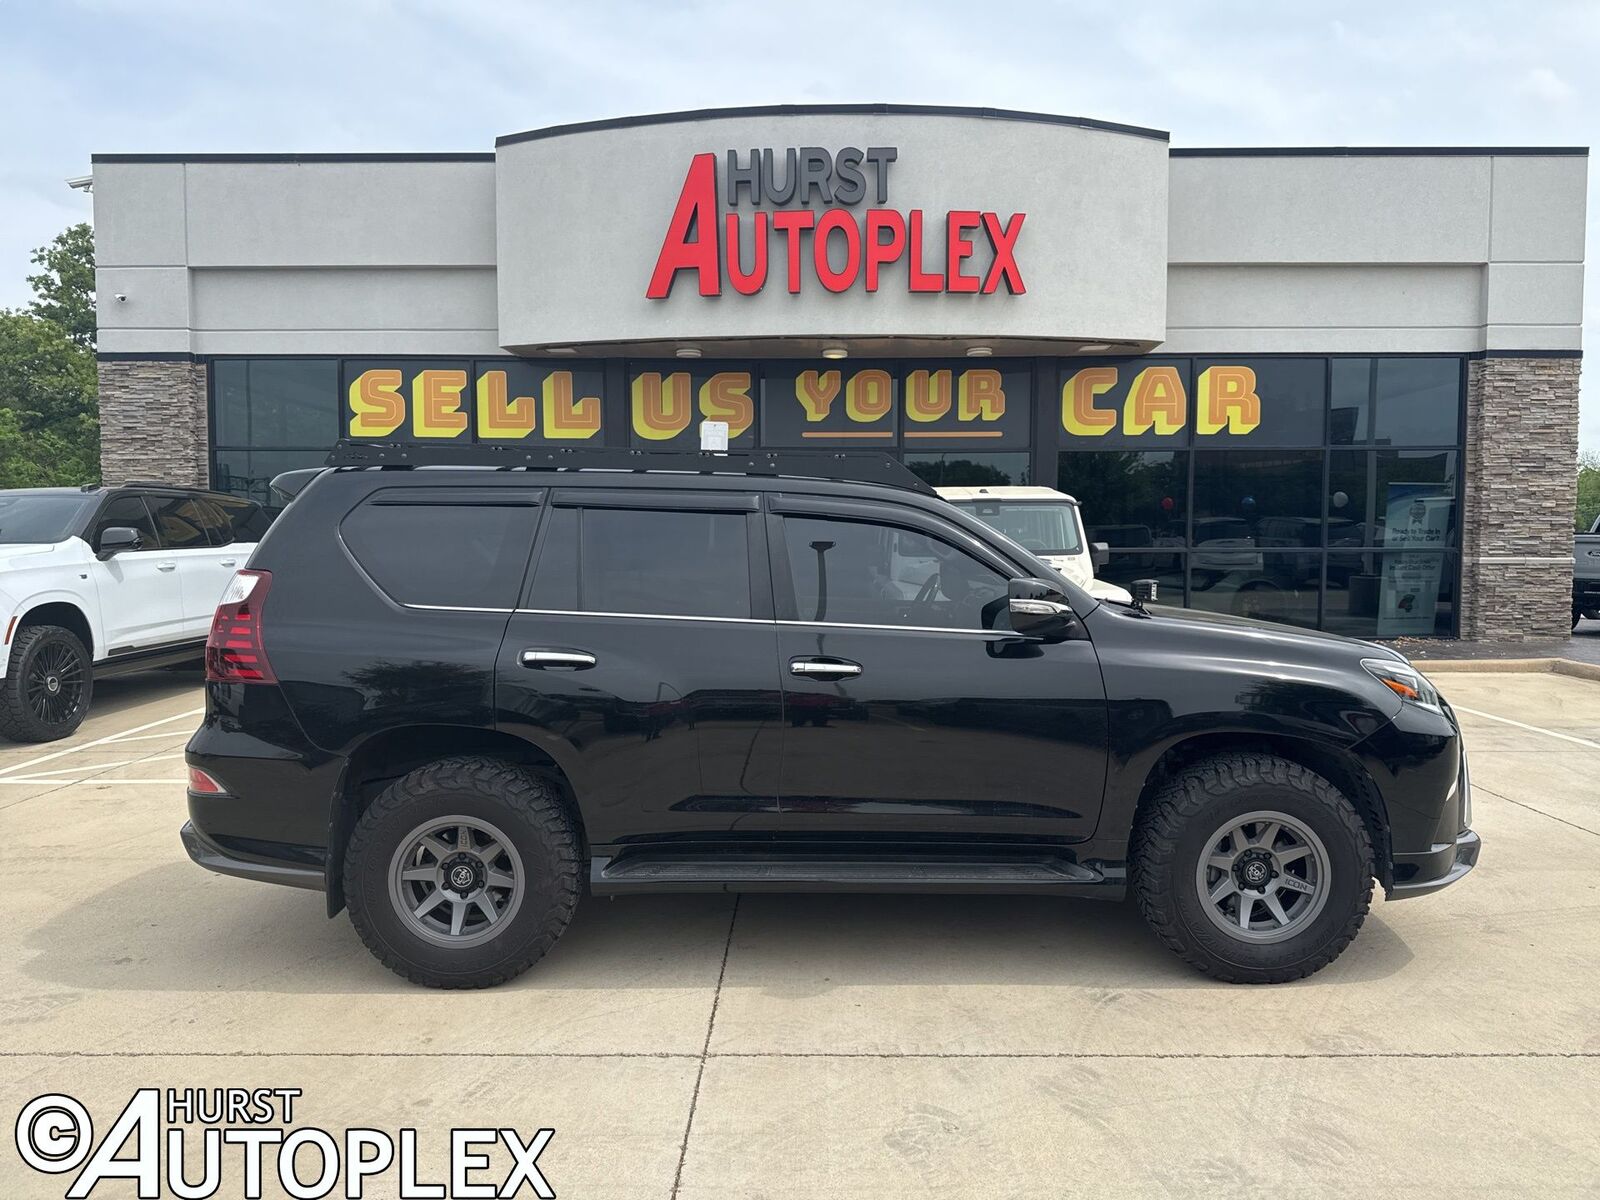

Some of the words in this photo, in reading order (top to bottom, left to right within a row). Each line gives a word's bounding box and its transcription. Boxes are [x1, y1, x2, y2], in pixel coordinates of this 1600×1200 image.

[727, 146, 898, 206] HURST
[646, 152, 1027, 299] AUTOPLEX
[349, 369, 601, 439] SELL
[632, 371, 754, 441] US
[795, 369, 1006, 423] YOUR
[1062, 366, 1261, 436] CAR
[1285, 879, 1308, 891] ICON
